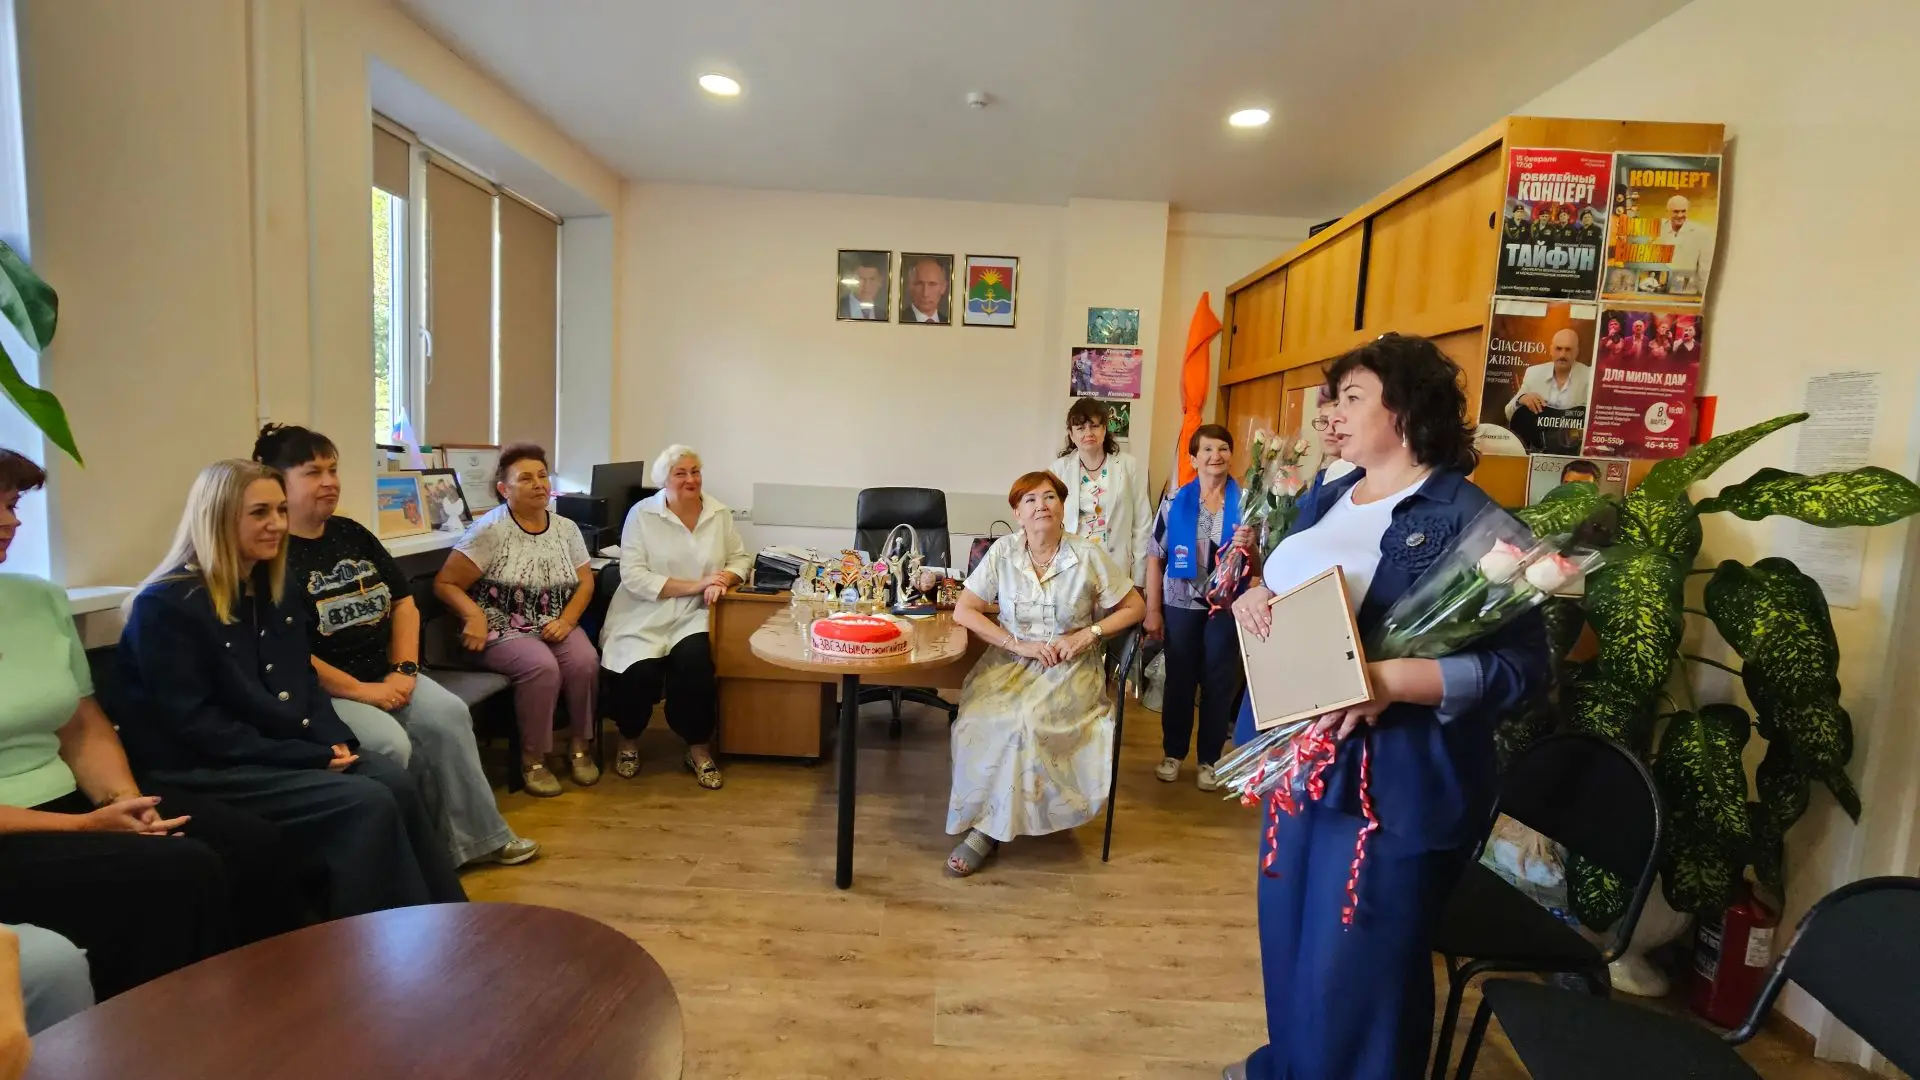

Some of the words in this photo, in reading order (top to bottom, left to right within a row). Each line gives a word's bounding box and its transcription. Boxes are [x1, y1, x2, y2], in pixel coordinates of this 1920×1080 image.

[1520, 172, 1596, 184] ЮБИЛЕЙНЫЙ
[1630, 169, 1710, 190] КОНЦЕРТ
[1517, 181, 1595, 205] КОНЦЕРТ
[1506, 240, 1596, 271] ТАЙФУН
[1602, 368, 1625, 382] ДЛЯ
[1625, 371, 1663, 384] МИЛЫХ
[1663, 373, 1687, 386] ДАМ
[1657, 406, 1664, 417] 8
[1537, 416, 1583, 429] КОПЕЙКИН
[1645, 441, 1679, 450] 46-4-95
